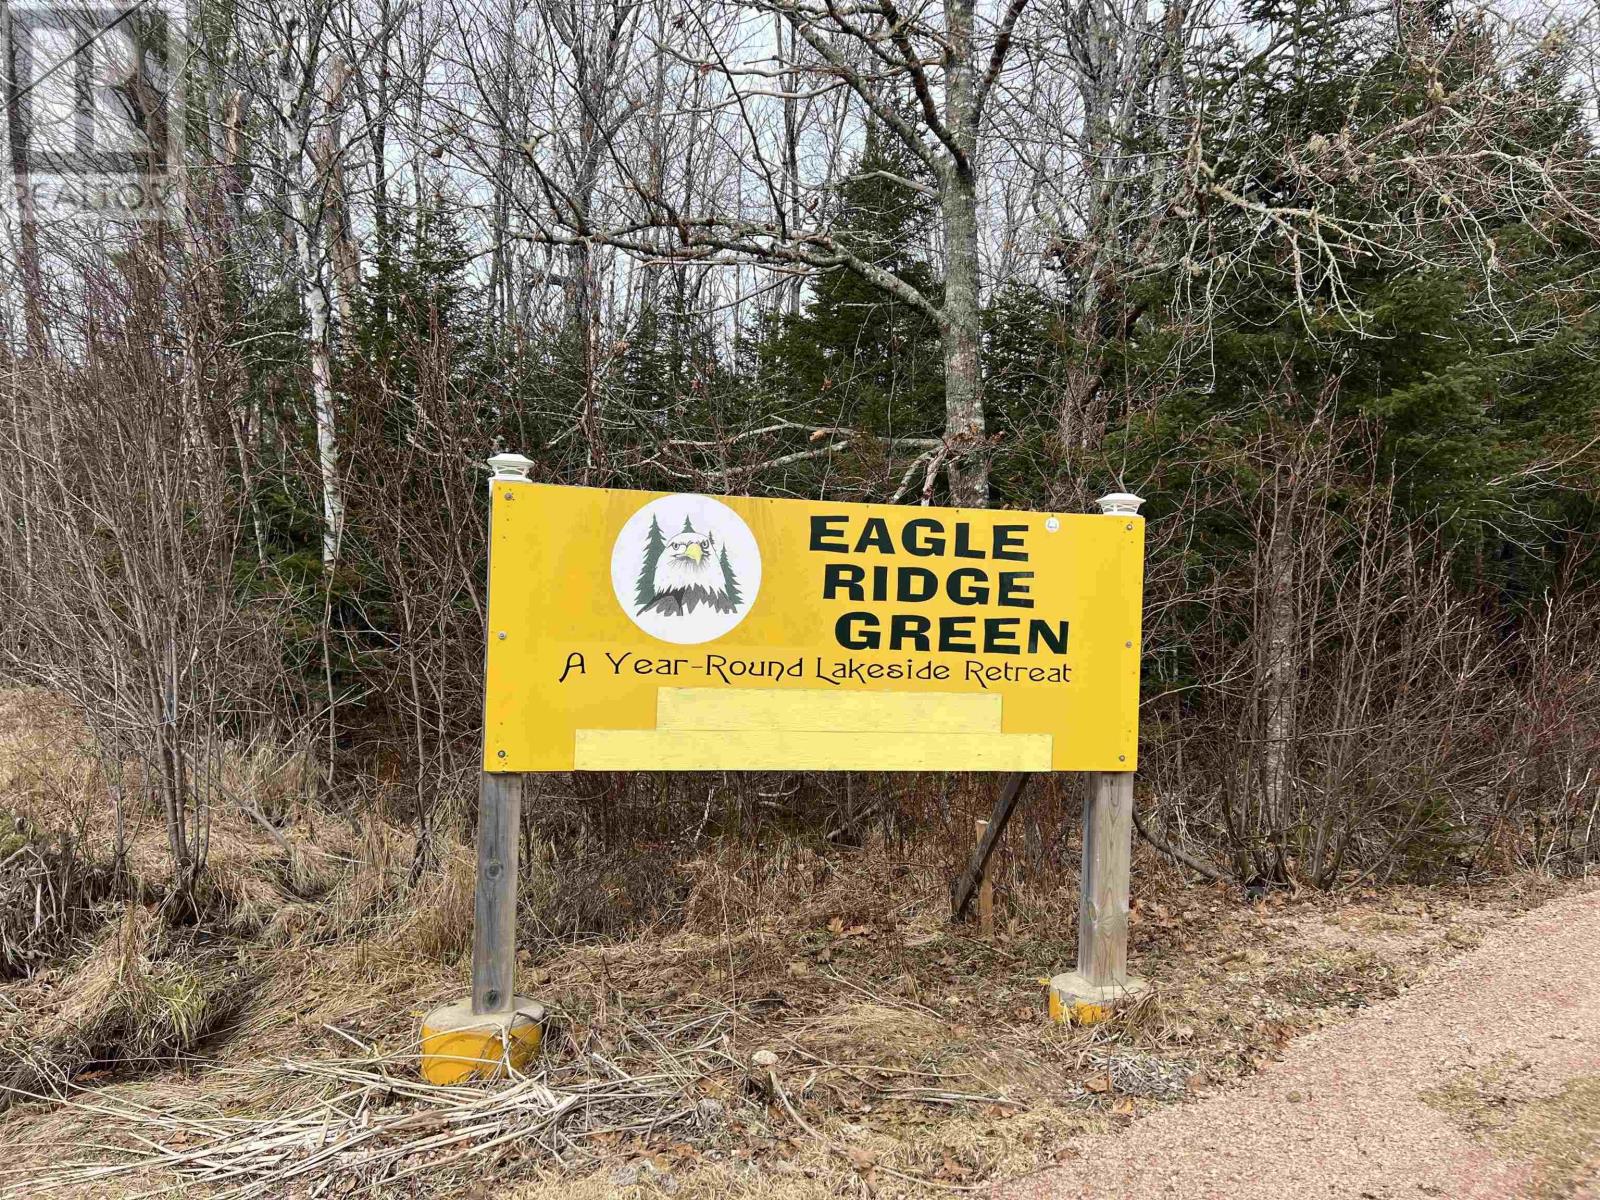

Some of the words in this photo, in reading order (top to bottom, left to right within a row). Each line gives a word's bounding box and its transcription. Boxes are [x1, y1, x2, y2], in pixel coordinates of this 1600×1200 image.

[809, 515, 1030, 562] EAGLE
[822, 563, 1036, 609] RIDGE
[834, 611, 1070, 655] GREEN
[557, 651, 587, 684] A
[604, 652, 805, 687] Year-Round
[815, 656, 951, 687] Lakeside
[964, 660, 1073, 690] Retreat
